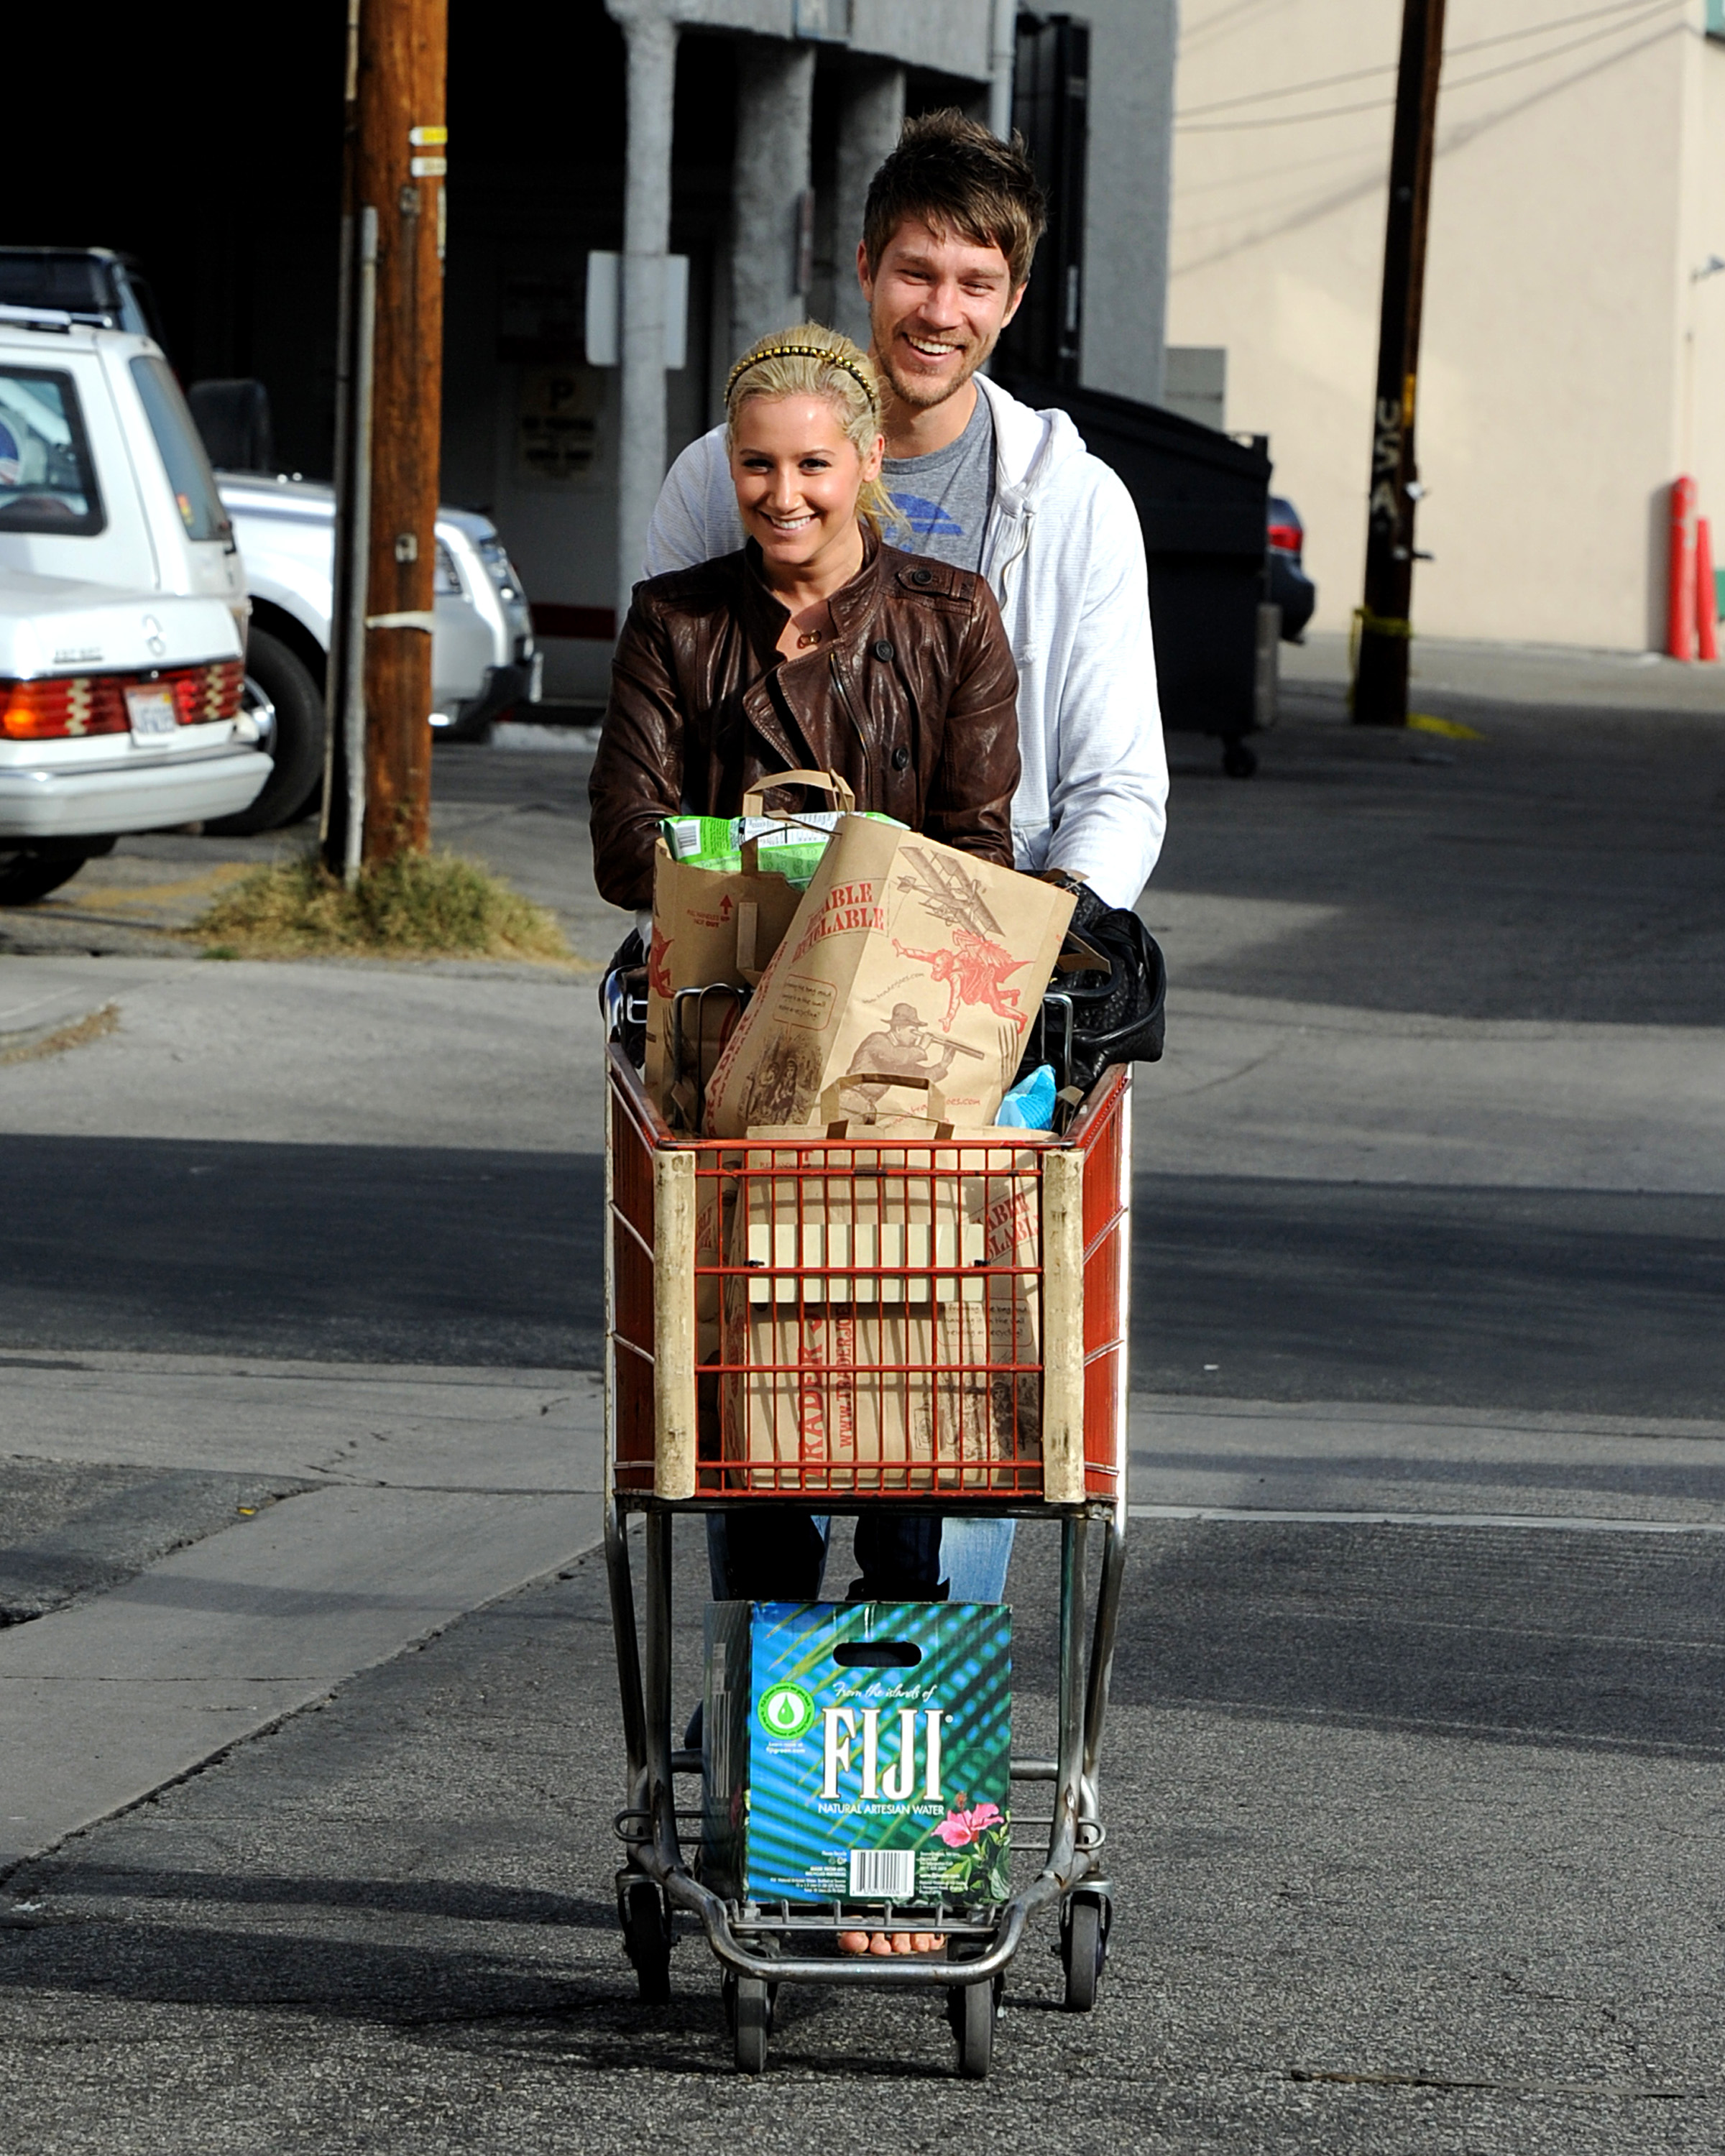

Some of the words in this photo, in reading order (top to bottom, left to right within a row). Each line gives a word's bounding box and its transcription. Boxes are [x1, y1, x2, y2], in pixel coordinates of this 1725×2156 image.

[798, 1345, 824, 1478] TRADER
[832, 1681, 862, 1697] From
[864, 1682, 884, 1697] the
[886, 1682, 921, 1699] islands
[922, 1685, 937, 1703] of
[819, 1708, 944, 1802] FIJI
[818, 1803, 862, 1815] NATURAL
[863, 1803, 911, 1815] ARTESIAN
[912, 1805, 945, 1816] WATER
